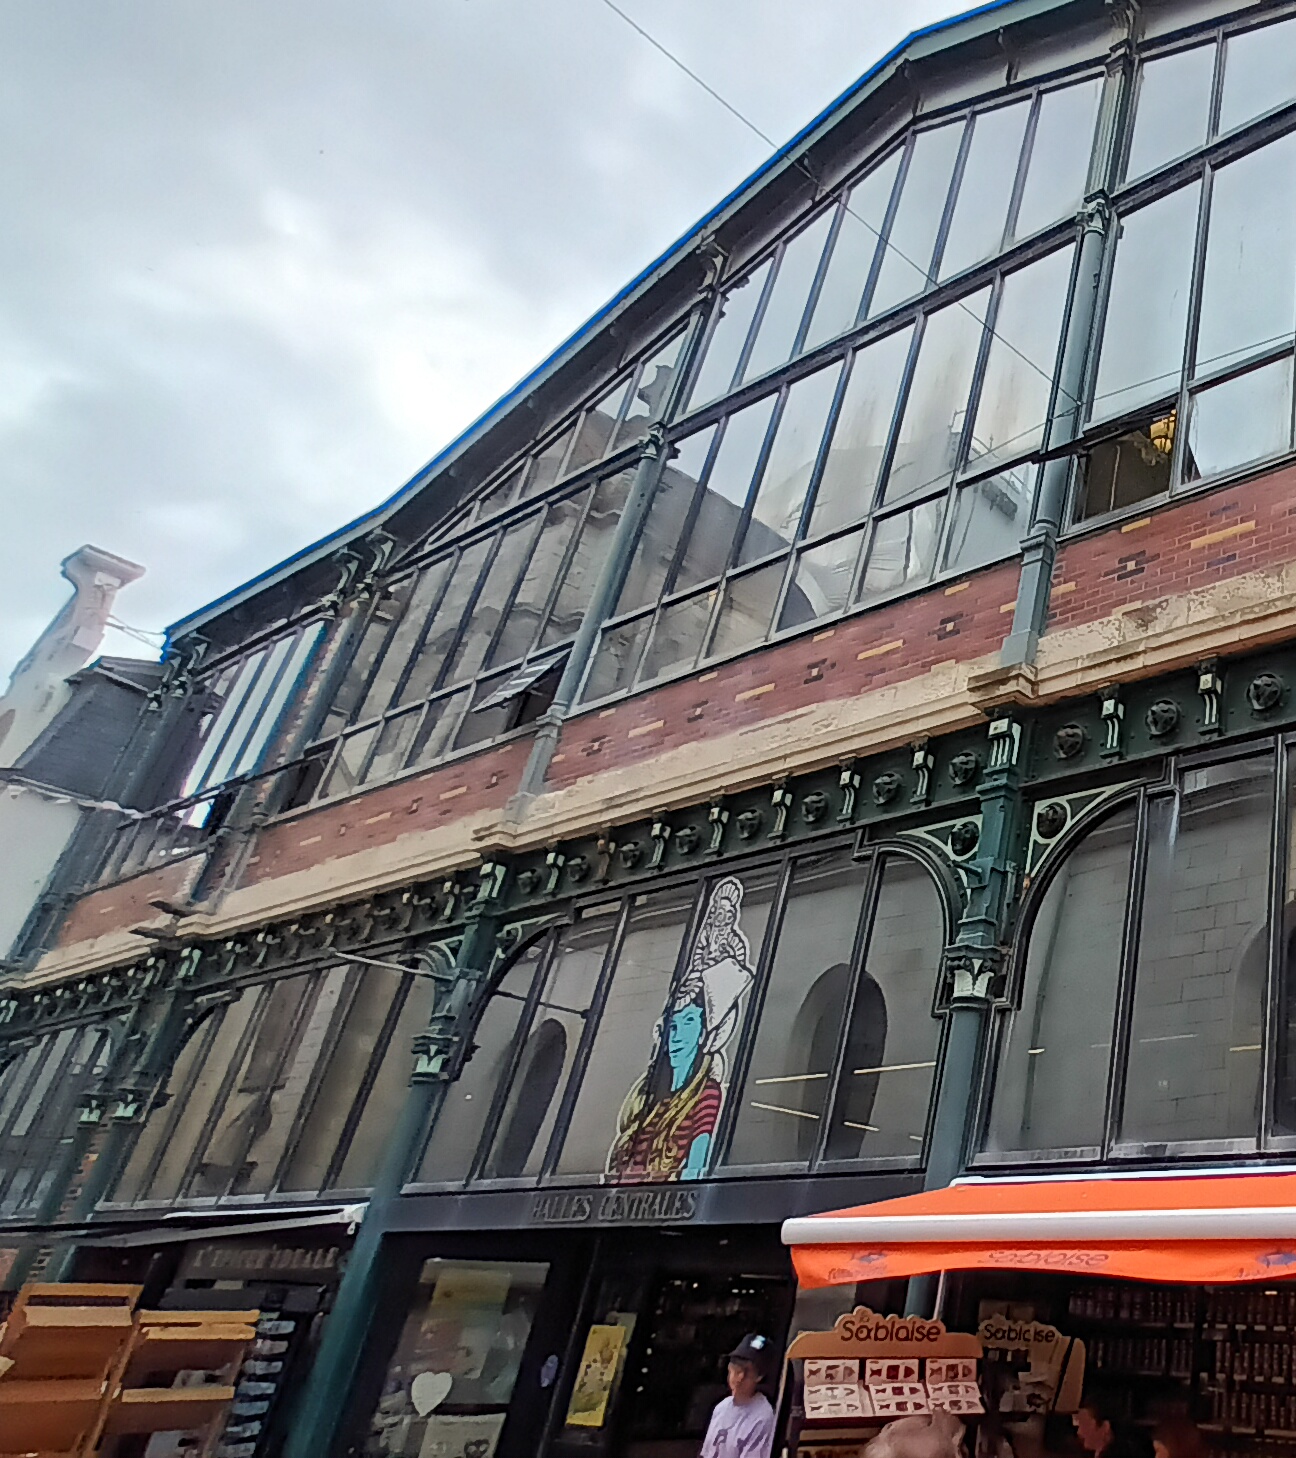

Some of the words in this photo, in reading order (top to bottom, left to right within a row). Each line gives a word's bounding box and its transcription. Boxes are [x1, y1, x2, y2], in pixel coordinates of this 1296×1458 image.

[533, 1194, 593, 1222] HALLES
[598, 1191, 697, 1220] CENTRALES
[841, 1320, 941, 1342] Sablaise
